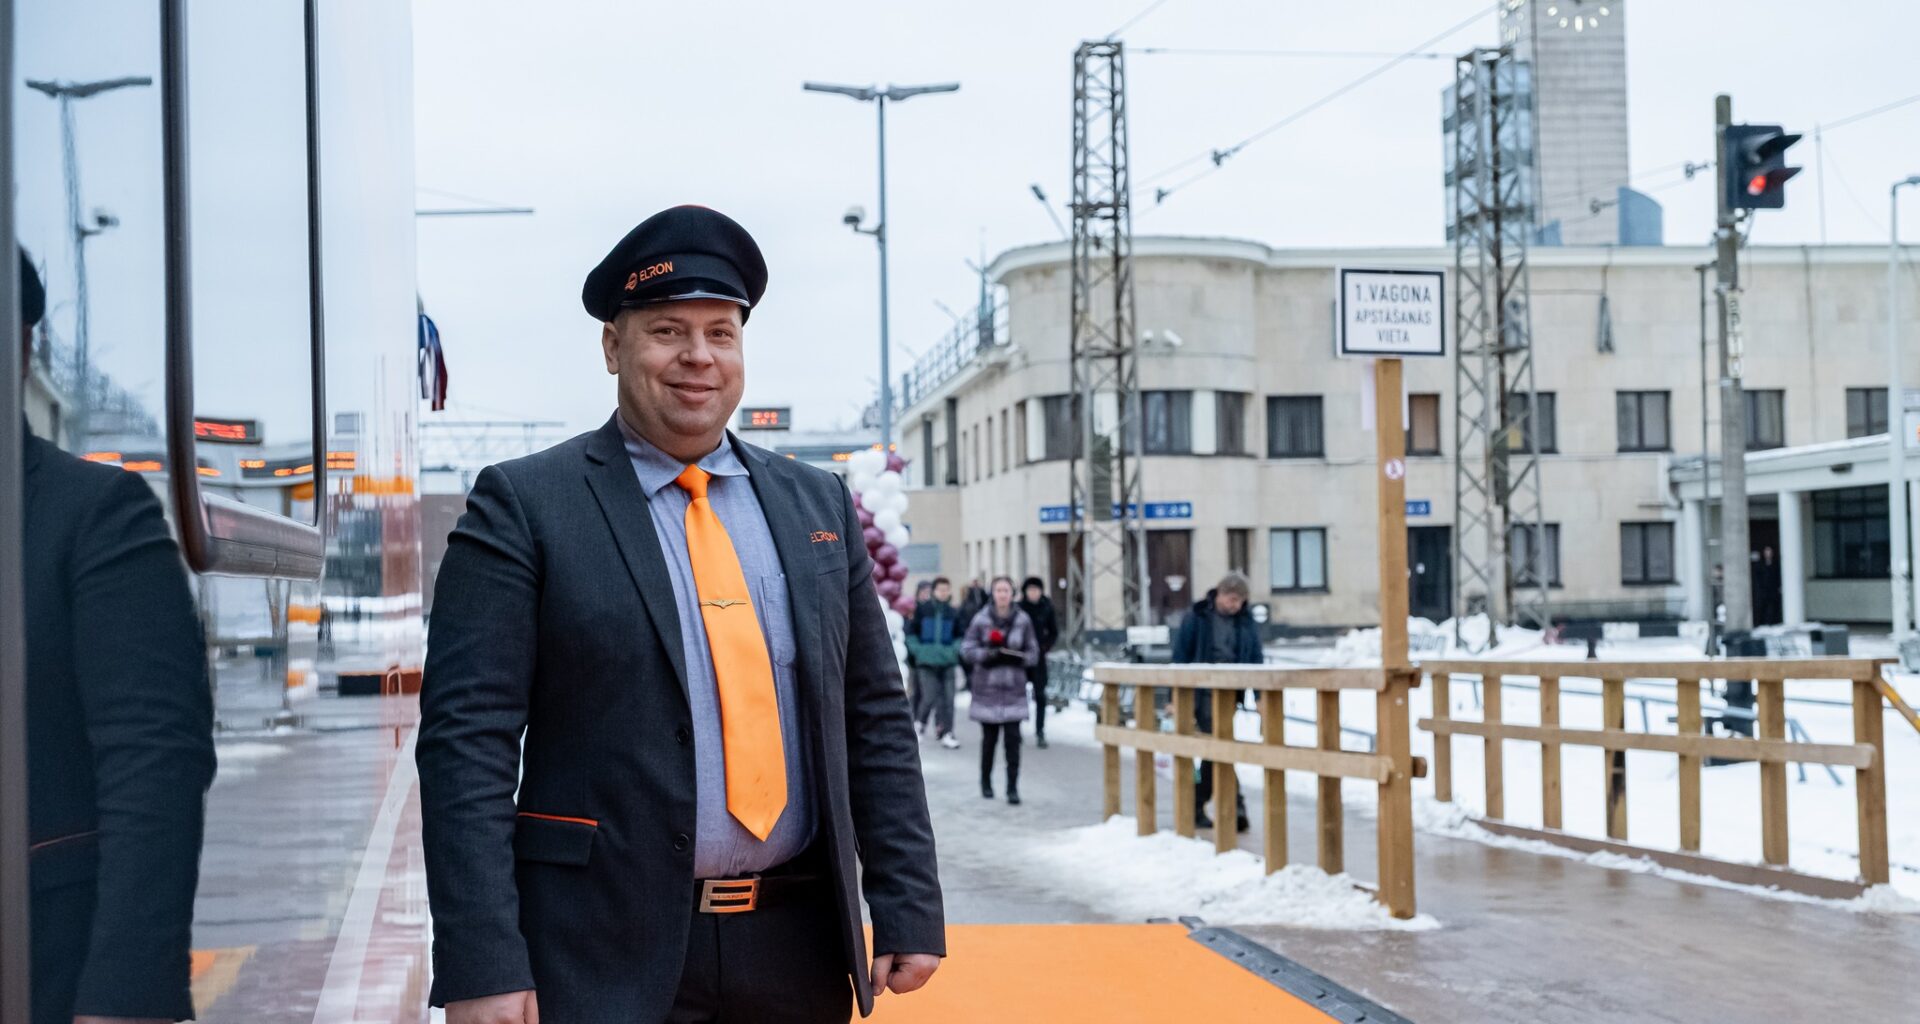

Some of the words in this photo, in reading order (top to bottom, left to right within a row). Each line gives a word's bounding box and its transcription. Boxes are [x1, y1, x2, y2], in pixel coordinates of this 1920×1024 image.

[640, 261, 673, 281] ELRON
[1377, 329, 1410, 343] VIETA
[810, 531, 839, 543] ELRON
